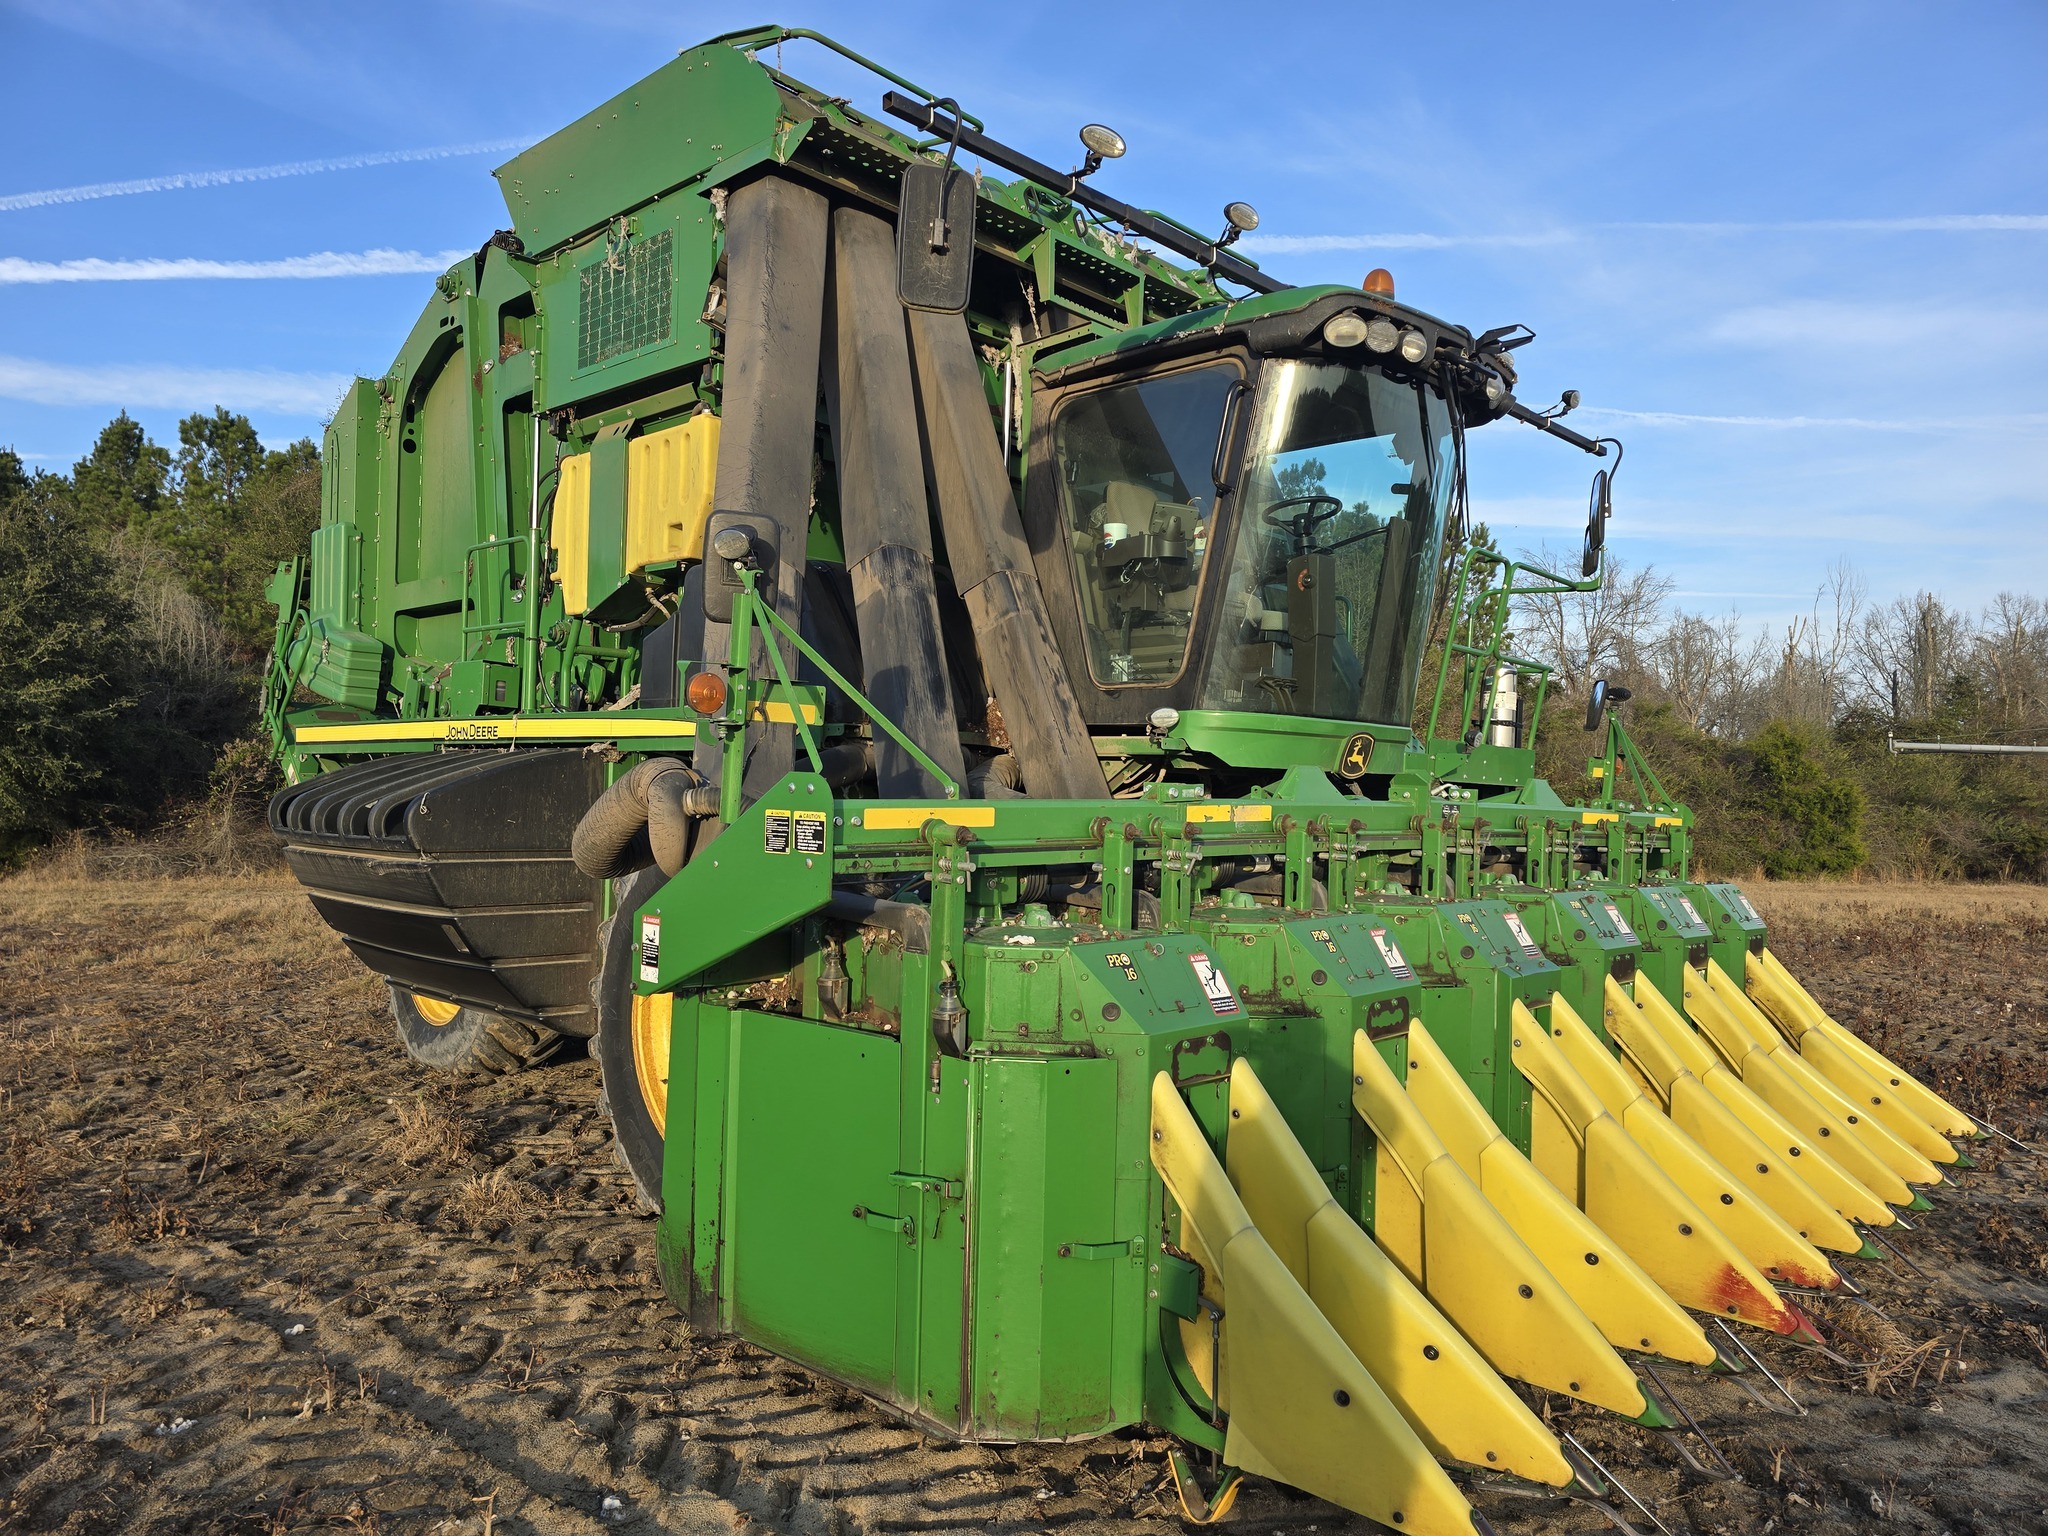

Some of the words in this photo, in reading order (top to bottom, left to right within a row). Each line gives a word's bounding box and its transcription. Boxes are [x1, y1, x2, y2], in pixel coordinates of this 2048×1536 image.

[445, 724, 469, 738] JOHN
[469, 723, 499, 738] DEERE
[1311, 930, 1330, 941] PRO
[1325, 941, 1337, 953] 16
[1106, 953, 1131, 967] PRO
[1124, 967, 1138, 981] 16
